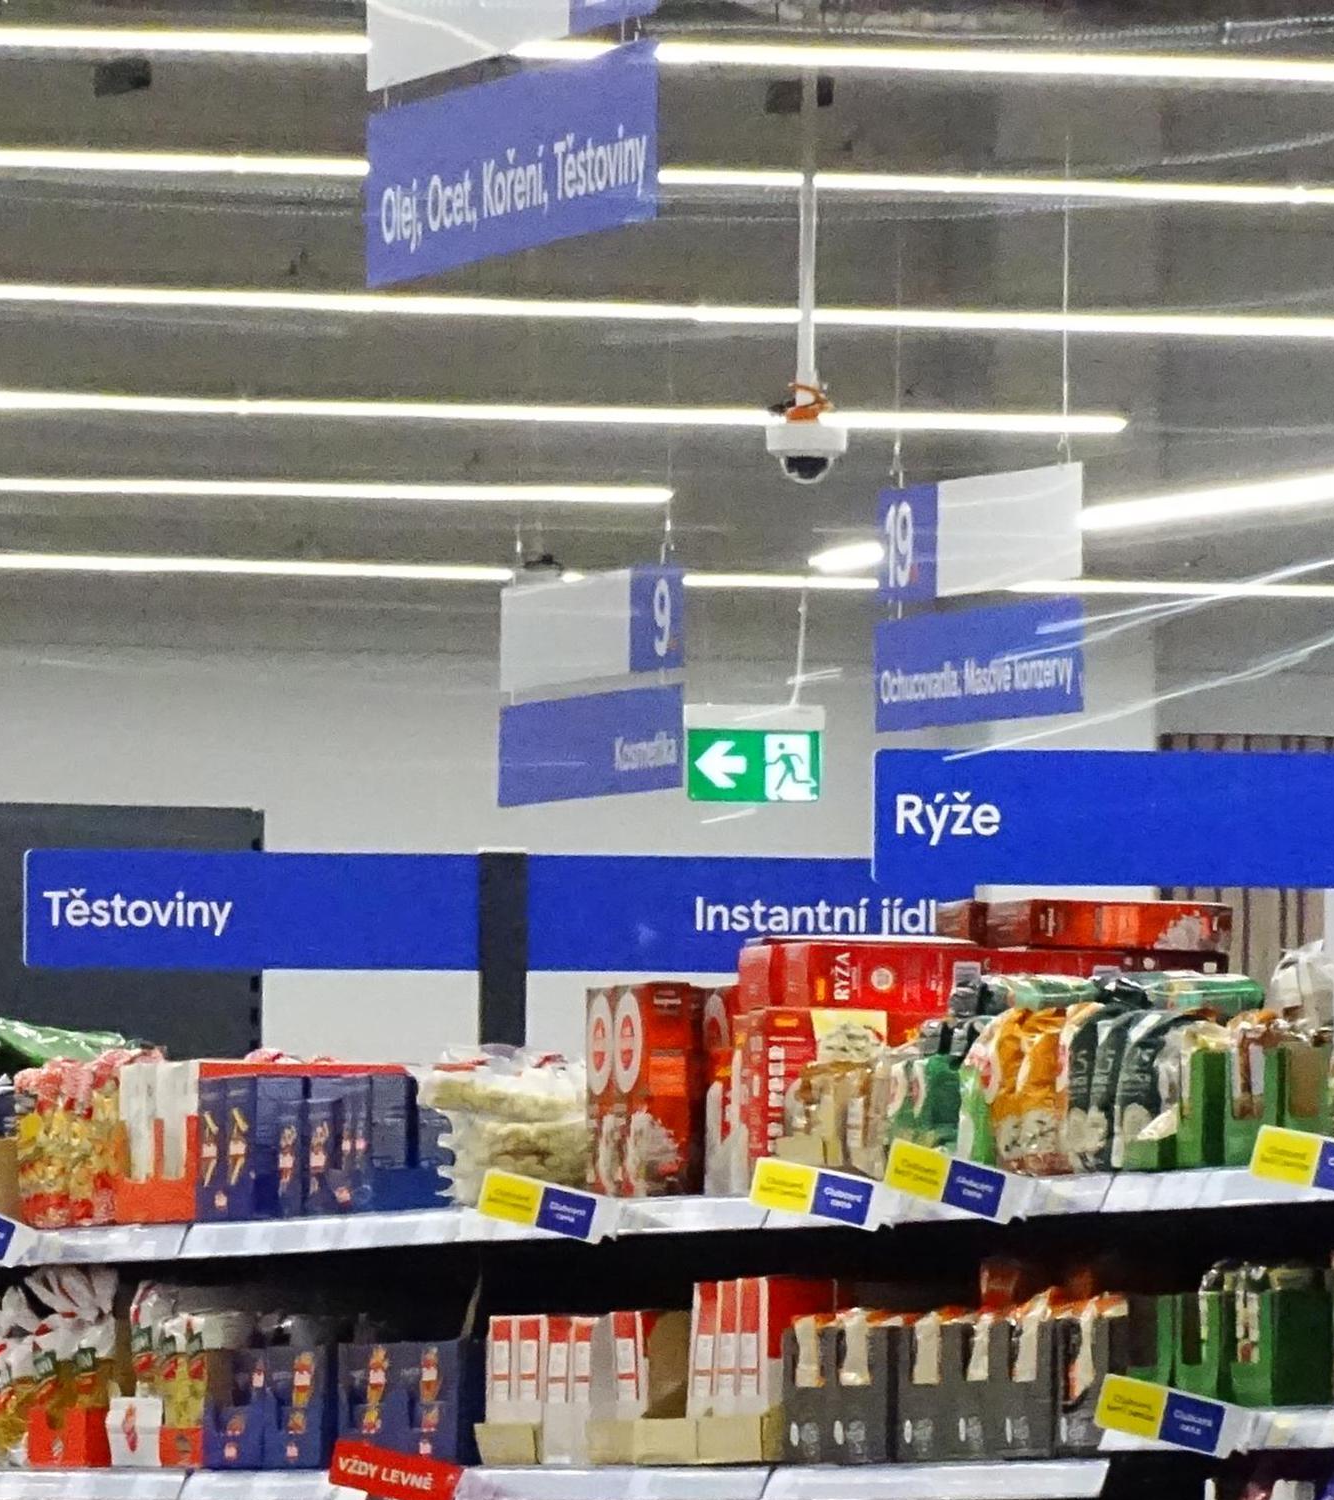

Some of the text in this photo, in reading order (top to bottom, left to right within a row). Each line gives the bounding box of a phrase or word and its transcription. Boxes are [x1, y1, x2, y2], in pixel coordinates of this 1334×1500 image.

[381, 123, 647, 253] Olej, Ocet, Koření, Těstoviny
[885, 501, 914, 588] 19
[653, 577, 671, 657] 9
[895, 791, 1001, 846] Rýže
[42, 887, 233, 937] Těstoviny
[694, 896, 870, 934] Instantní
